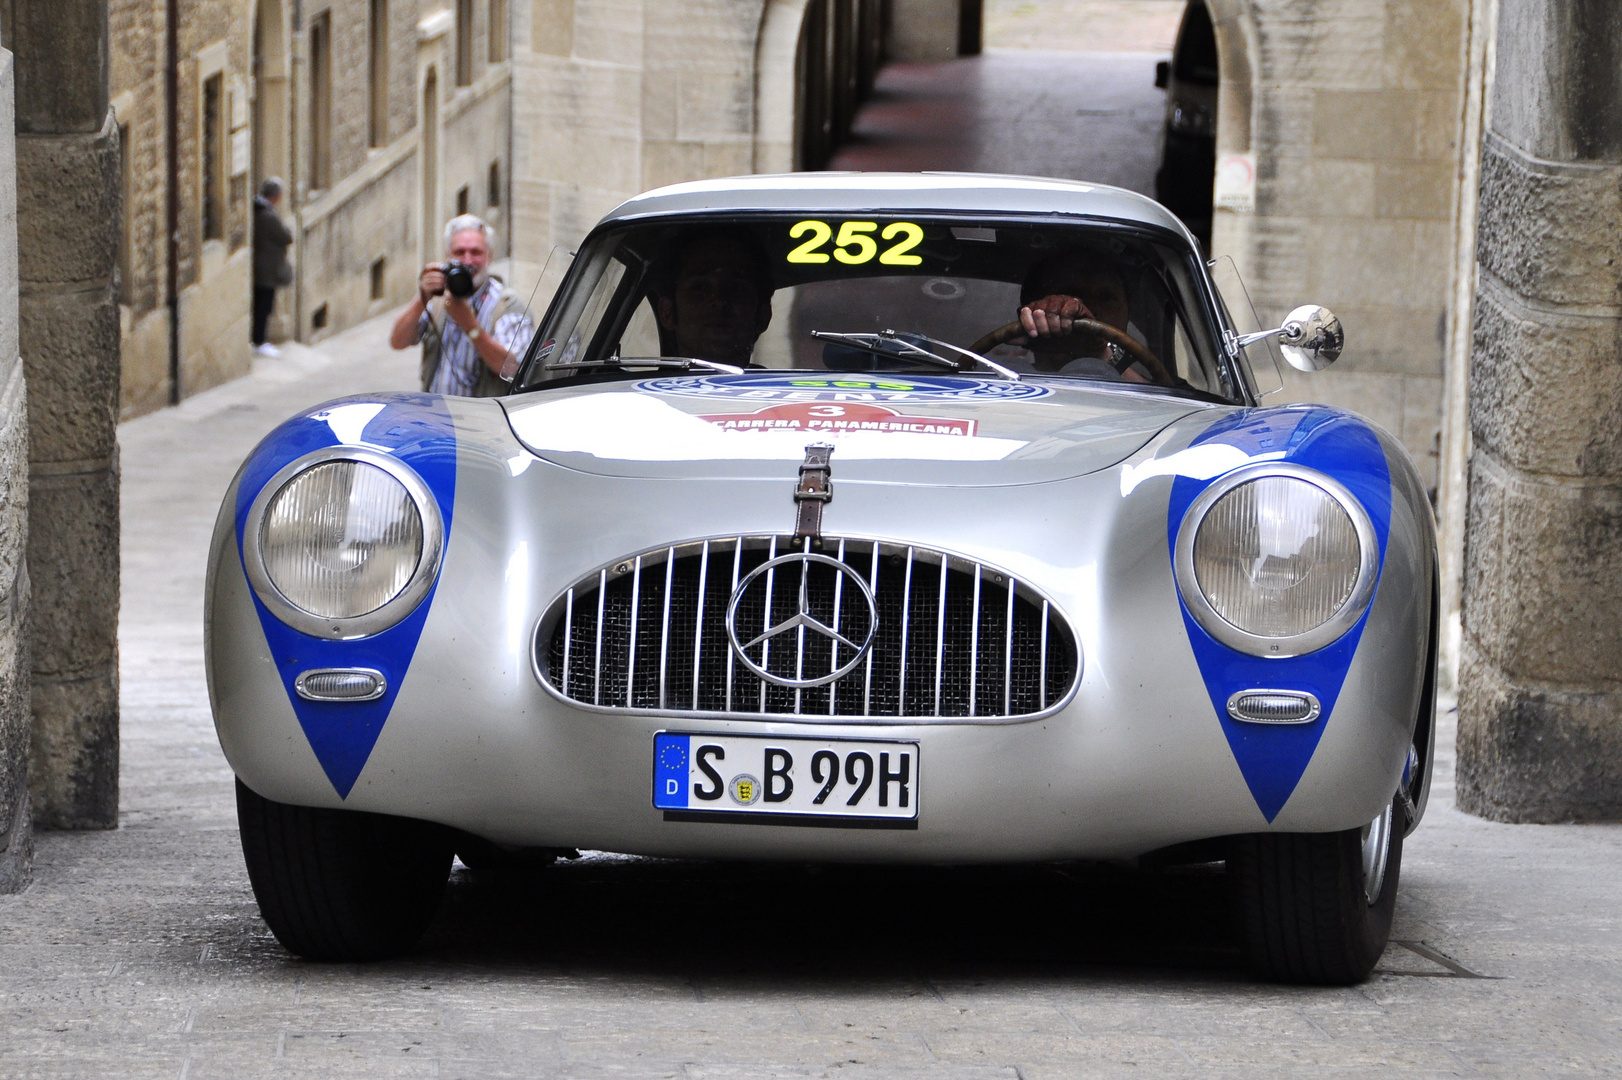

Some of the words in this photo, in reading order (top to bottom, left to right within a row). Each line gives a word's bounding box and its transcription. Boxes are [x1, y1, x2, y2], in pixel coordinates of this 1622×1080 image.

[786, 220, 924, 266] 252
[737, 391, 920, 401] BENZ
[808, 405, 846, 417] 3
[710, 419, 801, 429] CARRERA
[807, 420, 964, 436] PANAMERICANA
[693, 744, 726, 801] S
[763, 747, 794, 802] B
[810, 749, 911, 808] 99H
[666, 778, 679, 796] D
